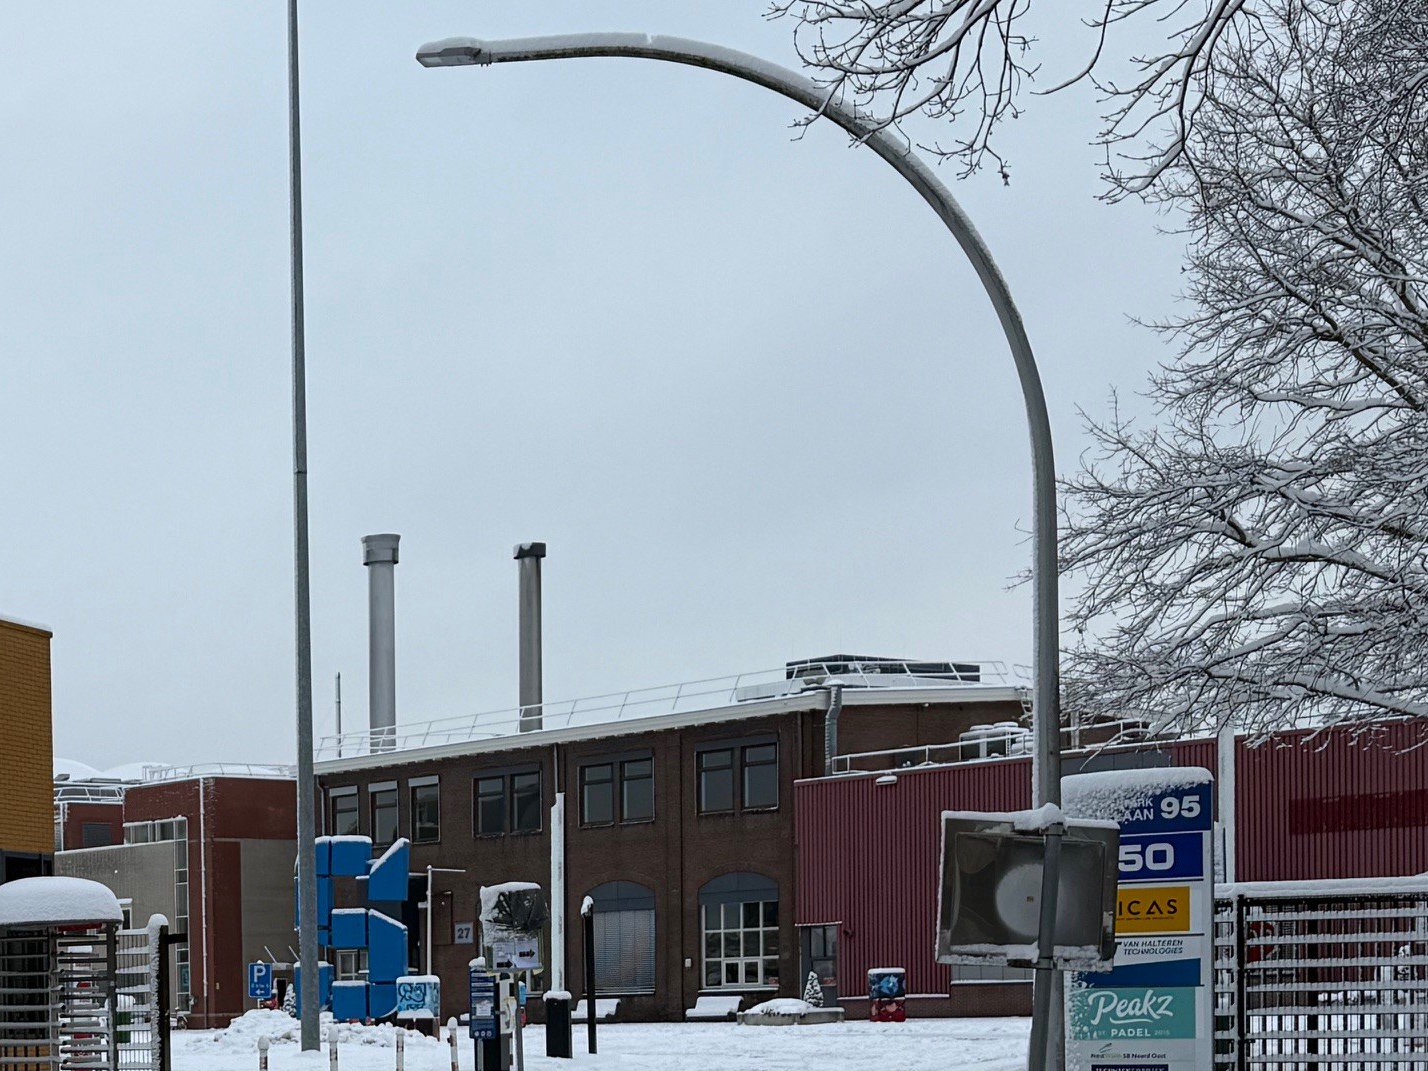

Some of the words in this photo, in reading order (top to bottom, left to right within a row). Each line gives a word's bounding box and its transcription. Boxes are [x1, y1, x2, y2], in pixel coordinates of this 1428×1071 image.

[1160, 795, 1201, 819] 95
[457, 927, 471, 939] 27
[1123, 940, 1140, 948] VAN
[1141, 939, 1184, 948] HALTEREN
[1123, 947, 1184, 956] TECHNOLOGIES
[253, 965, 267, 983] P
[1088, 989, 1174, 1025] Peakz
[1110, 1028, 1152, 1038] PADEL
